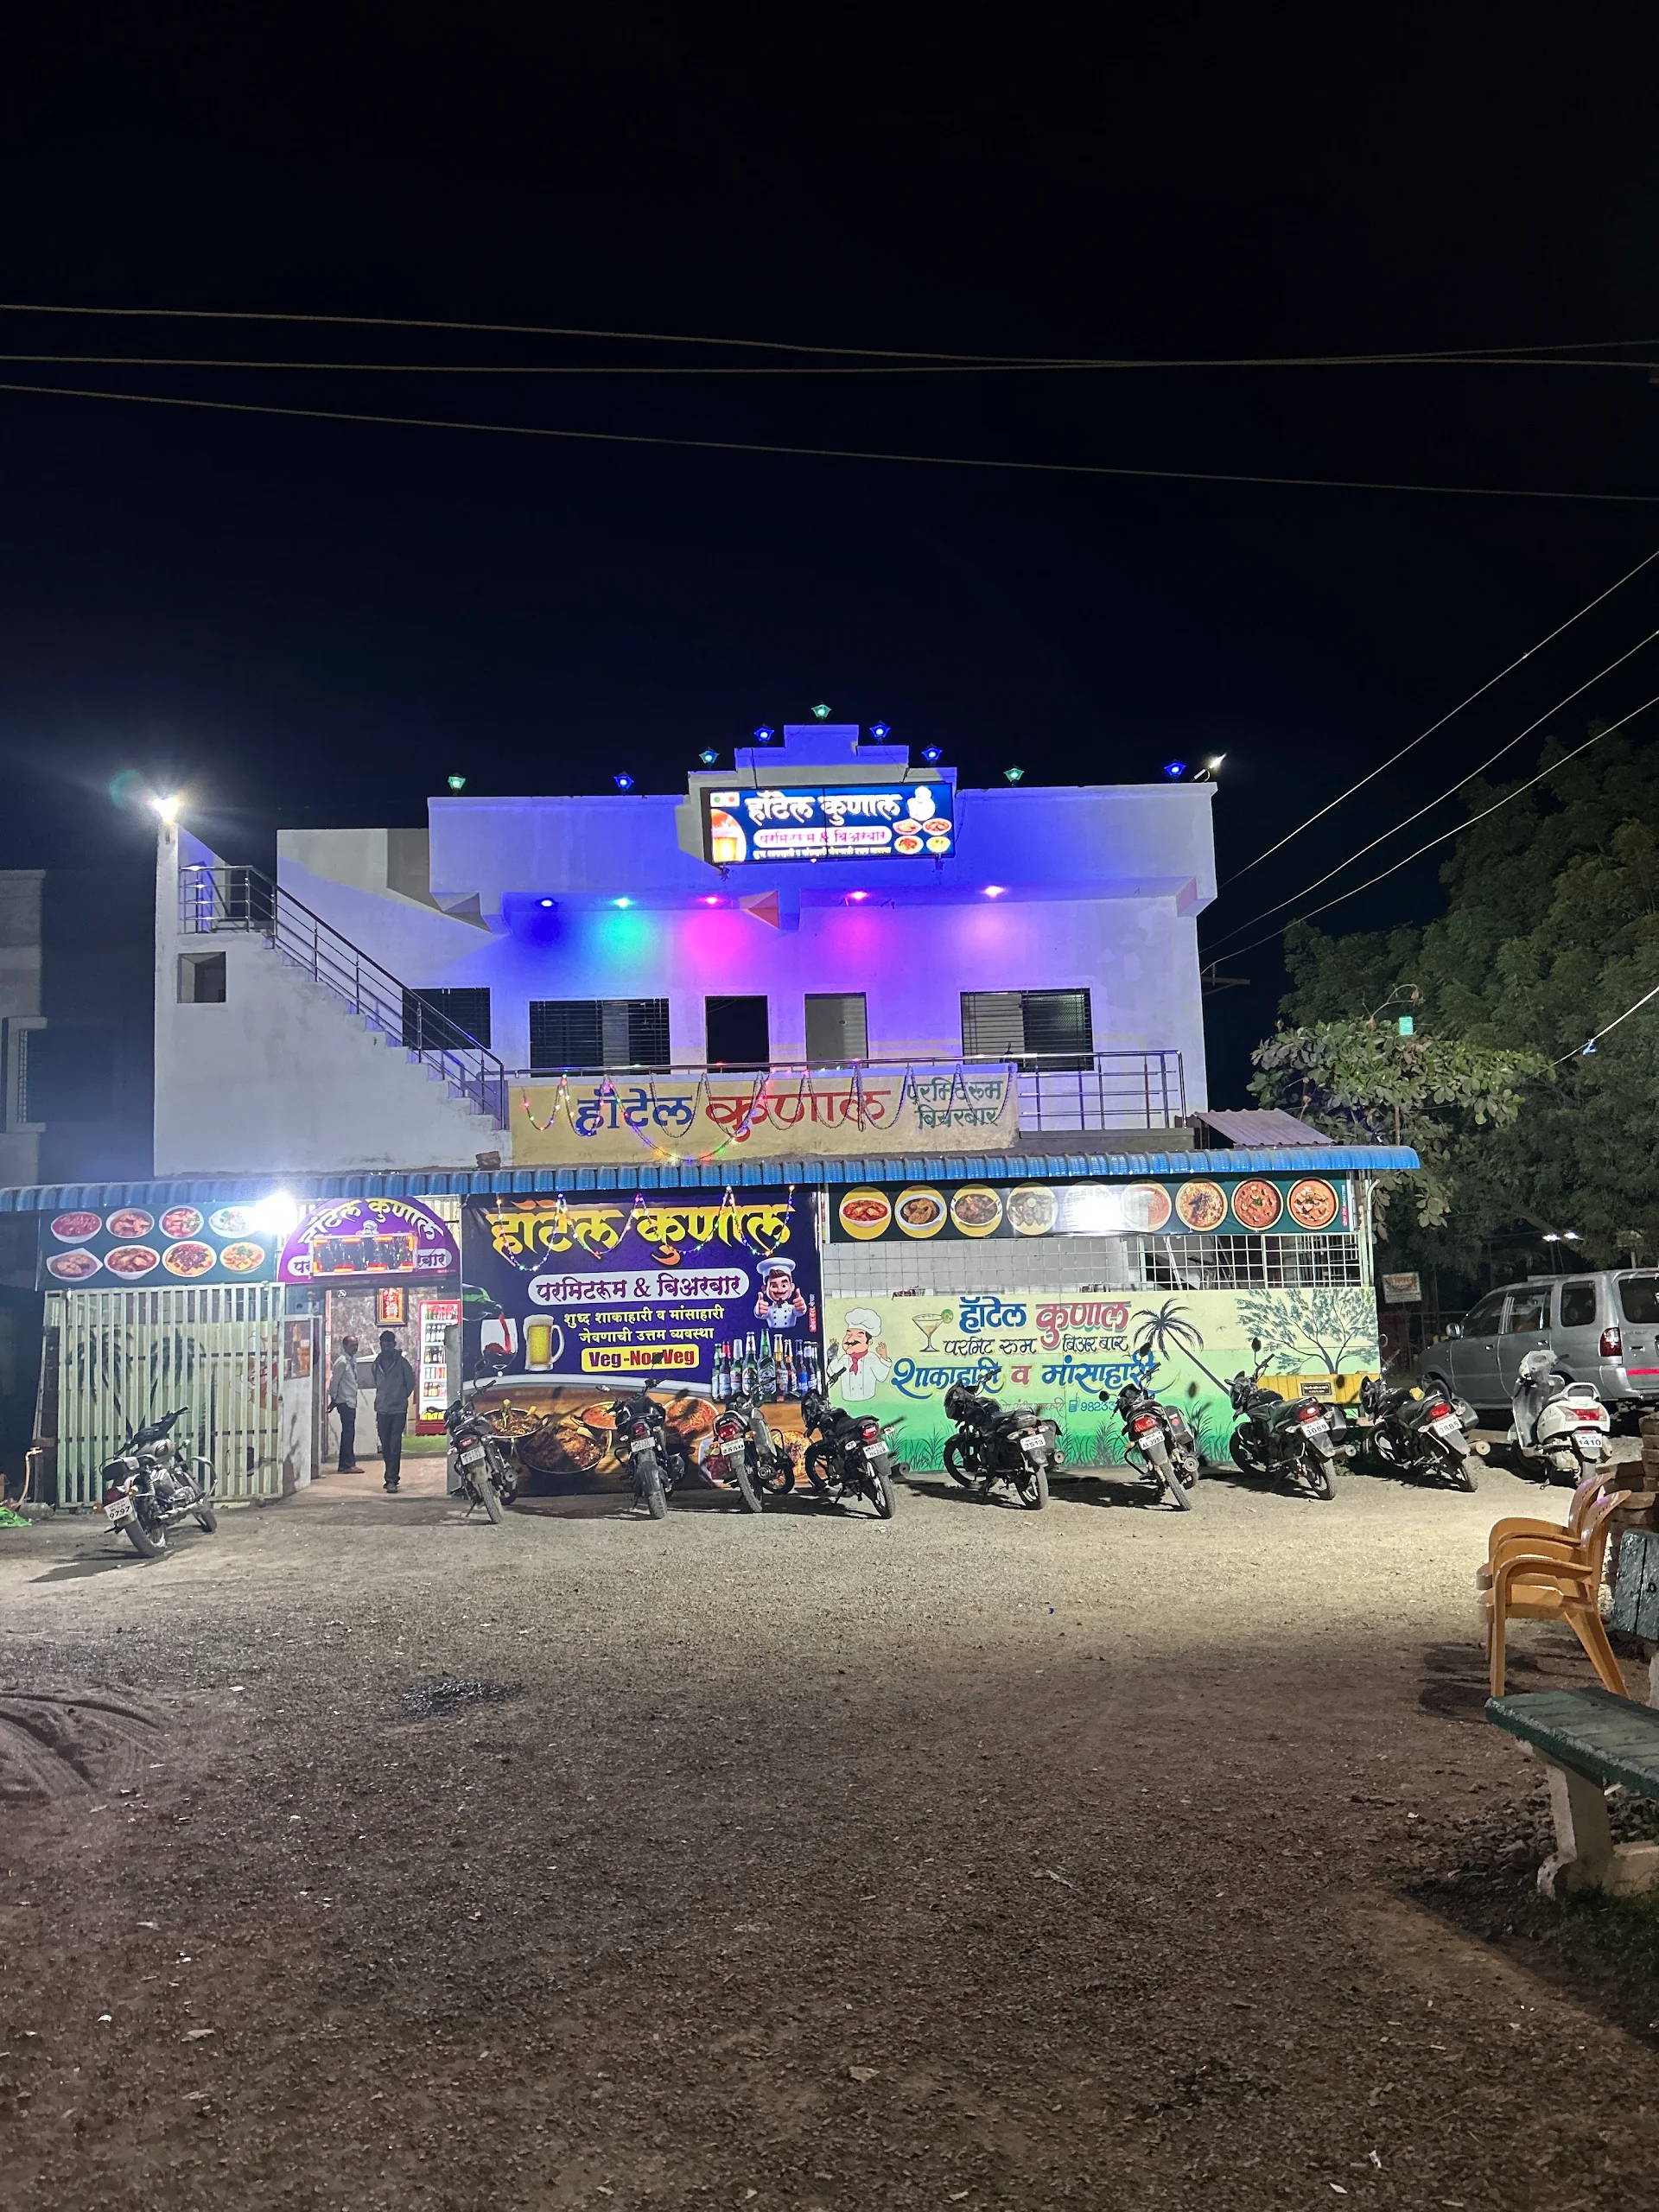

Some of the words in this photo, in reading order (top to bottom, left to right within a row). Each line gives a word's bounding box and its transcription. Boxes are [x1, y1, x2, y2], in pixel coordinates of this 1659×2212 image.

[745, 791, 815, 826] हॉटेल
[817, 794, 903, 826] कुणाल
[575, 1088, 693, 1136] हॉटेल
[705, 1090, 891, 1142] कुणाल
[365, 1198, 444, 1240] कुणाल
[486, 1198, 625, 1267] हॉटेल
[636, 1205, 796, 1266] कुणाल
[633, 1277, 651, 1297] &
[657, 1272, 741, 1297] बिअरबार
[594, 1306, 653, 1324] शाकाहारी
[656, 1310, 666, 1321] व
[669, 1304, 725, 1322] मांसाहारी
[958, 1295, 1027, 1334] हॉटेल
[1036, 1300, 1131, 1350] कुणाल
[578, 1326, 632, 1344] जेवणाची
[635, 1330, 666, 1342] उत्तम
[669, 1327, 715, 1340] व्यवस्था
[943, 1336, 995, 1355] परमिट
[892, 1357, 1003, 1399] शाकाहारी
[1011, 1365, 1030, 1385] व
[1041, 1351, 1166, 1394] मांसाहारी
